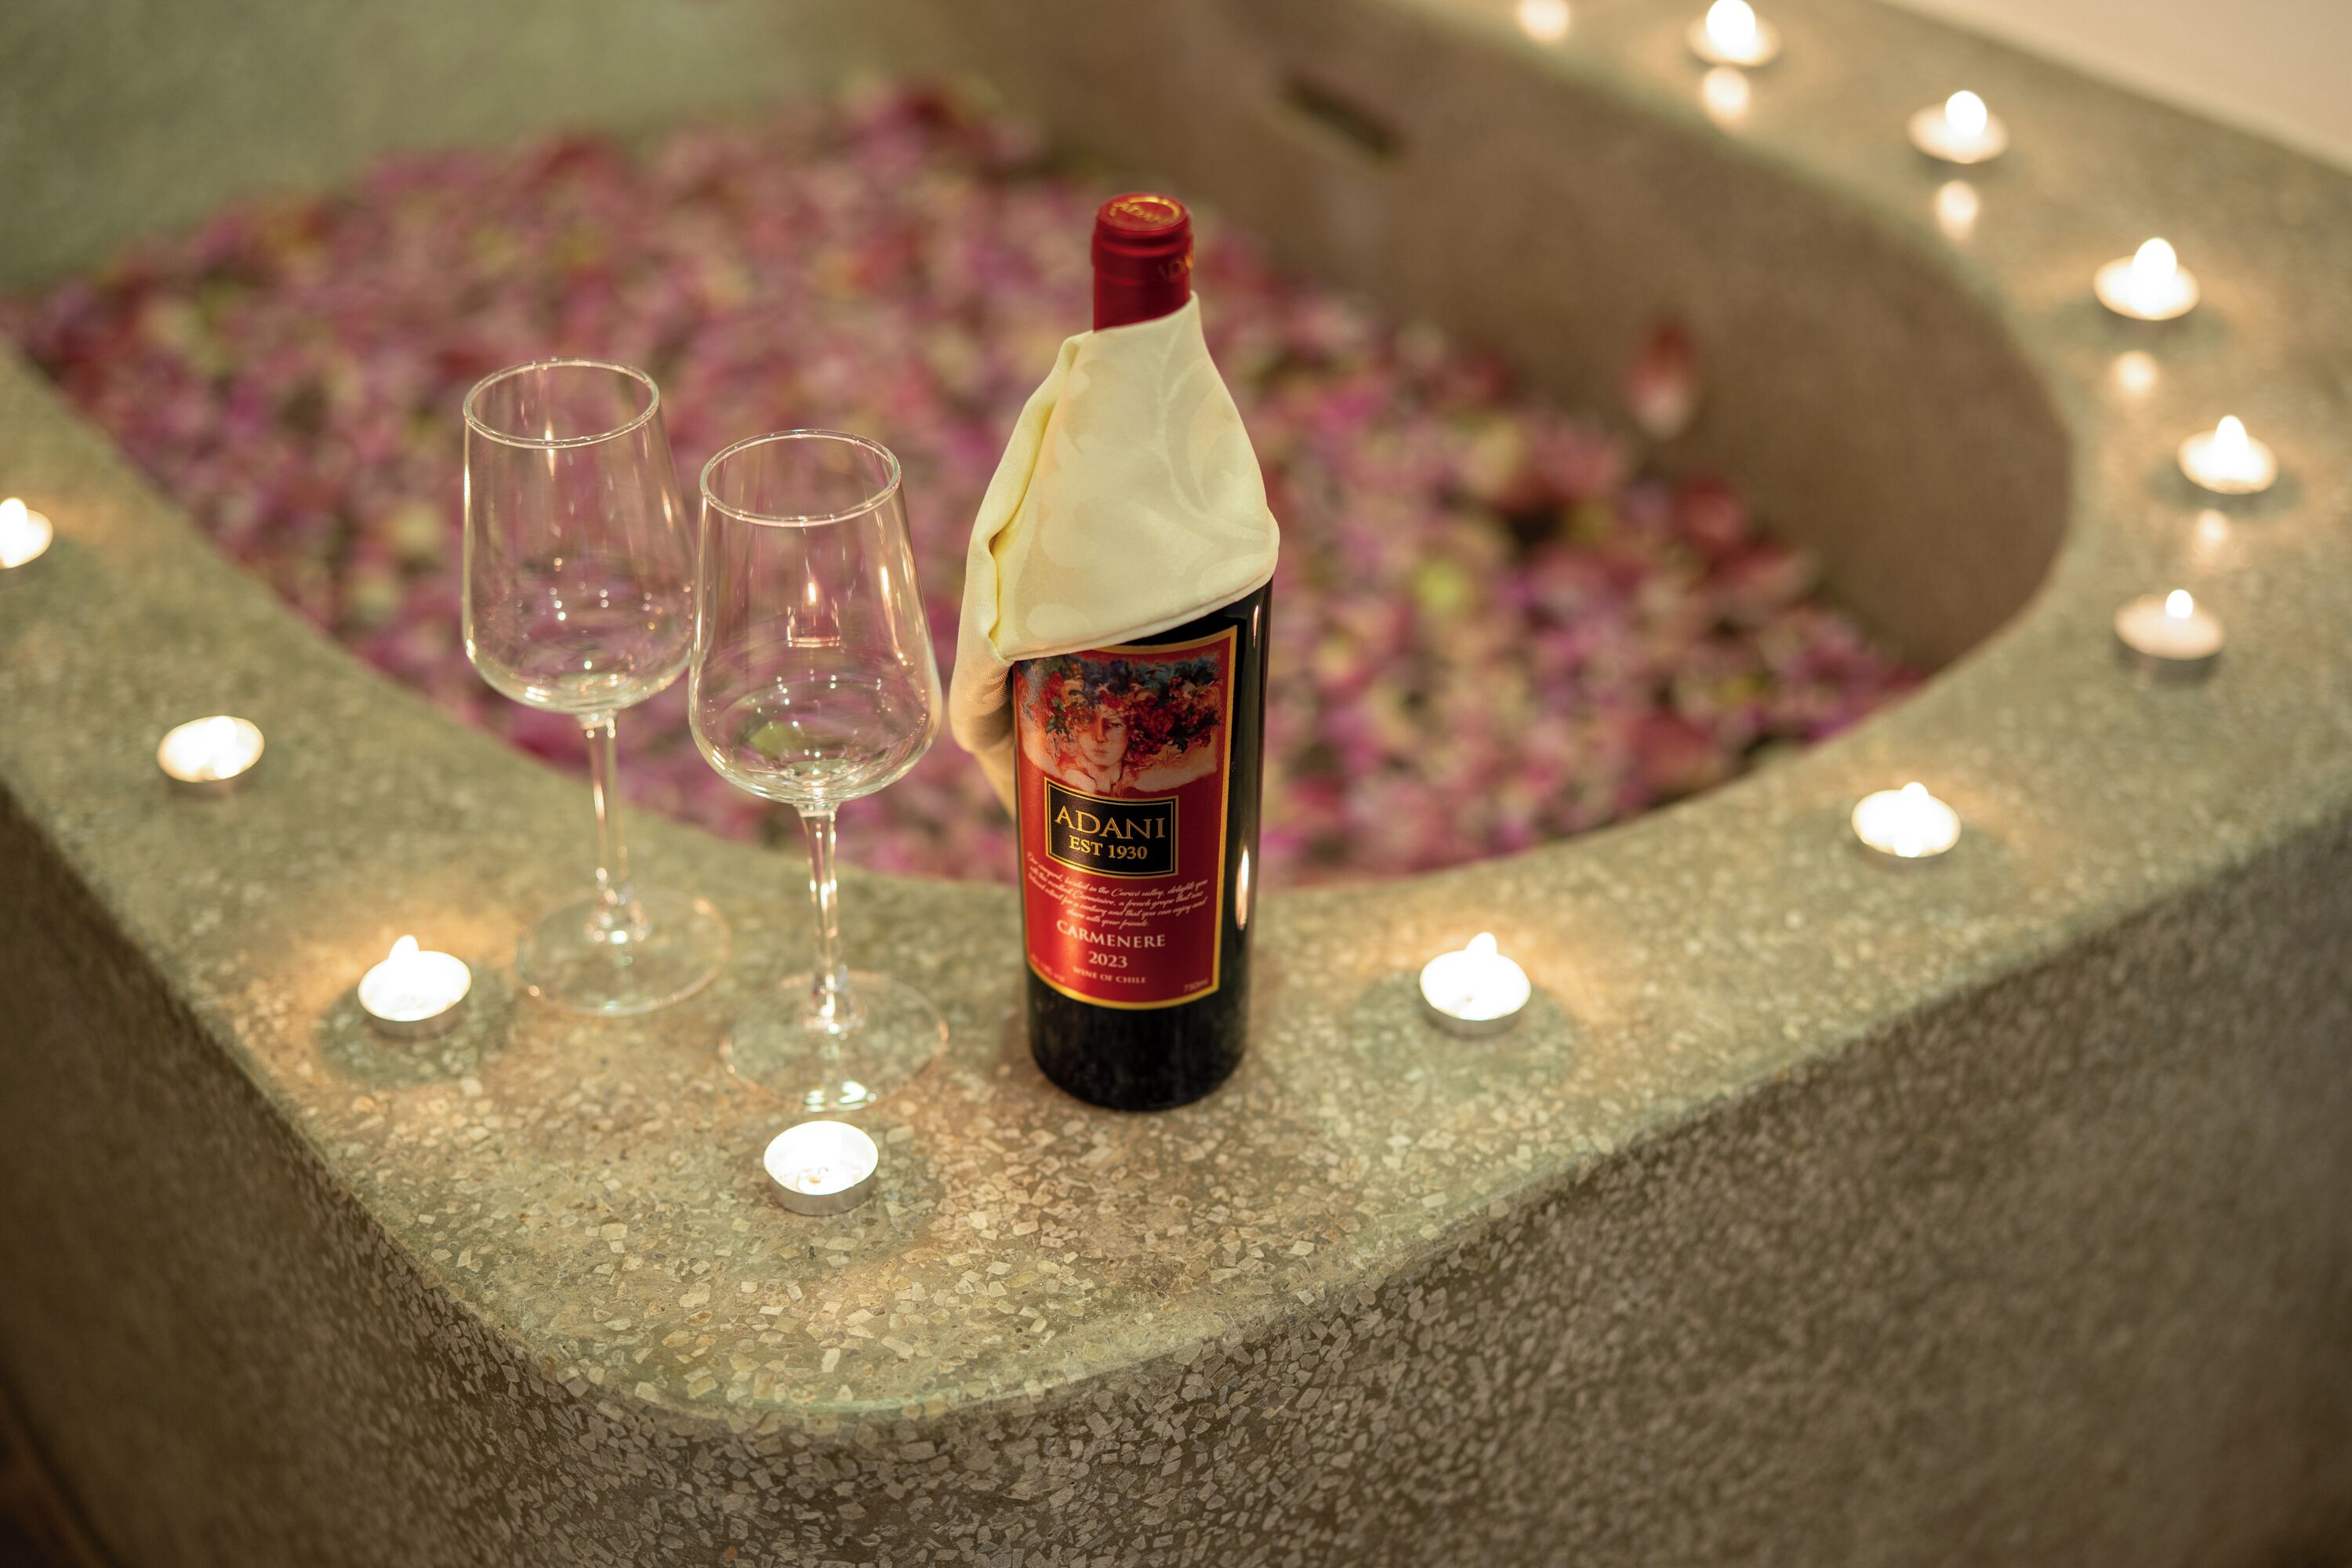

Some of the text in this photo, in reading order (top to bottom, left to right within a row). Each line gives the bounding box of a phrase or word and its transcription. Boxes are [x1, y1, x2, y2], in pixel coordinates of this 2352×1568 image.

[1054, 805, 1166, 840] ADANI
[1069, 835, 1148, 860] EST 1930
[1089, 883, 1097, 892] in
[1098, 886, 1109, 895] the
[1167, 881, 1195, 895] delights
[1123, 899, 1151, 913] french
[1149, 898, 1174, 910] grape
[1175, 892, 1192, 903] that
[1108, 908, 1125, 916] and
[1125, 909, 1143, 917] that
[1142, 911, 1156, 920] you
[1056, 919, 1166, 949] CARMENERE
[1088, 950, 1128, 969] 2023
[1072, 965, 1098, 979] WINE
[1116, 975, 1146, 985] CHILE
